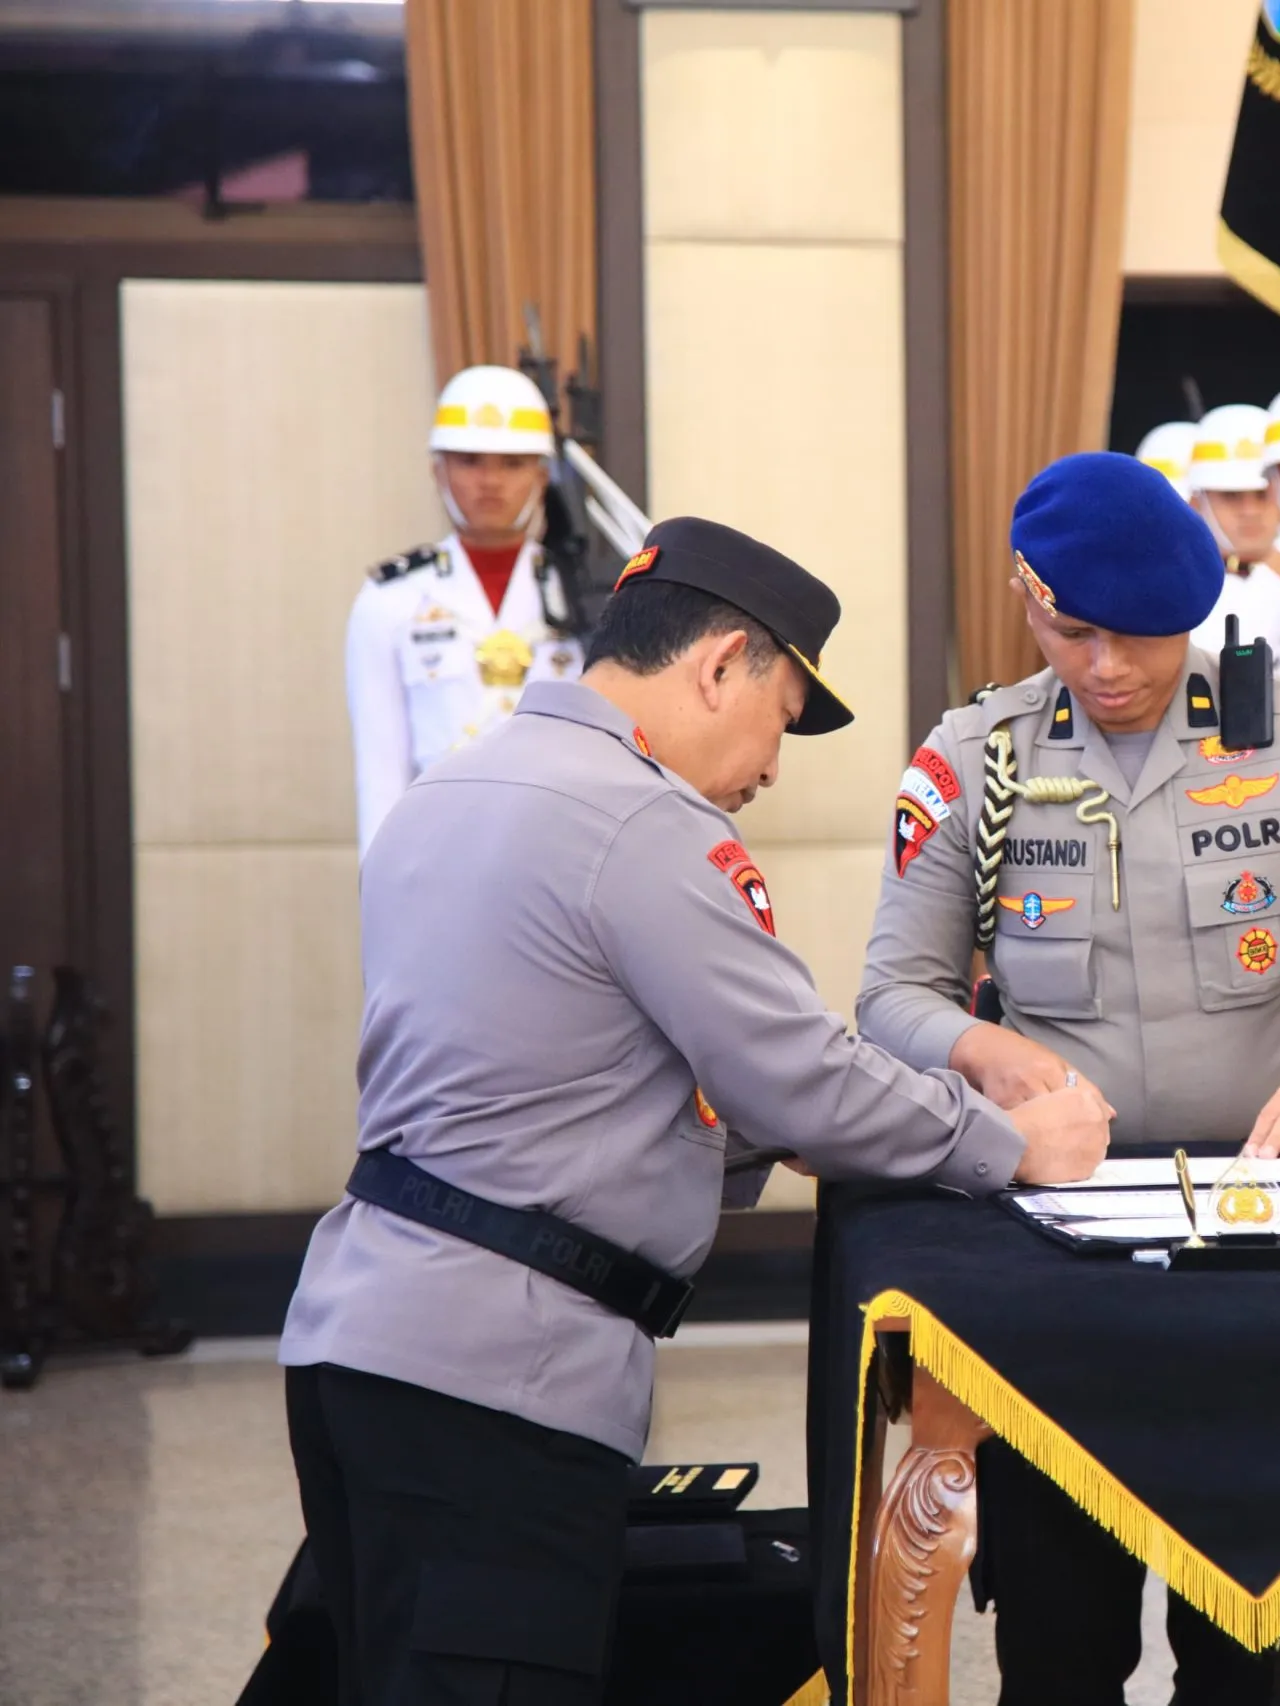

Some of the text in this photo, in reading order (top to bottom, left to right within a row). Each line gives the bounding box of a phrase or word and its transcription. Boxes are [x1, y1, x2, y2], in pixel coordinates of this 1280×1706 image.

[1003, 838, 1087, 867] RUSTANDI
[398, 1174, 475, 1224] POLRI
[528, 1228, 613, 1285] POLRI
